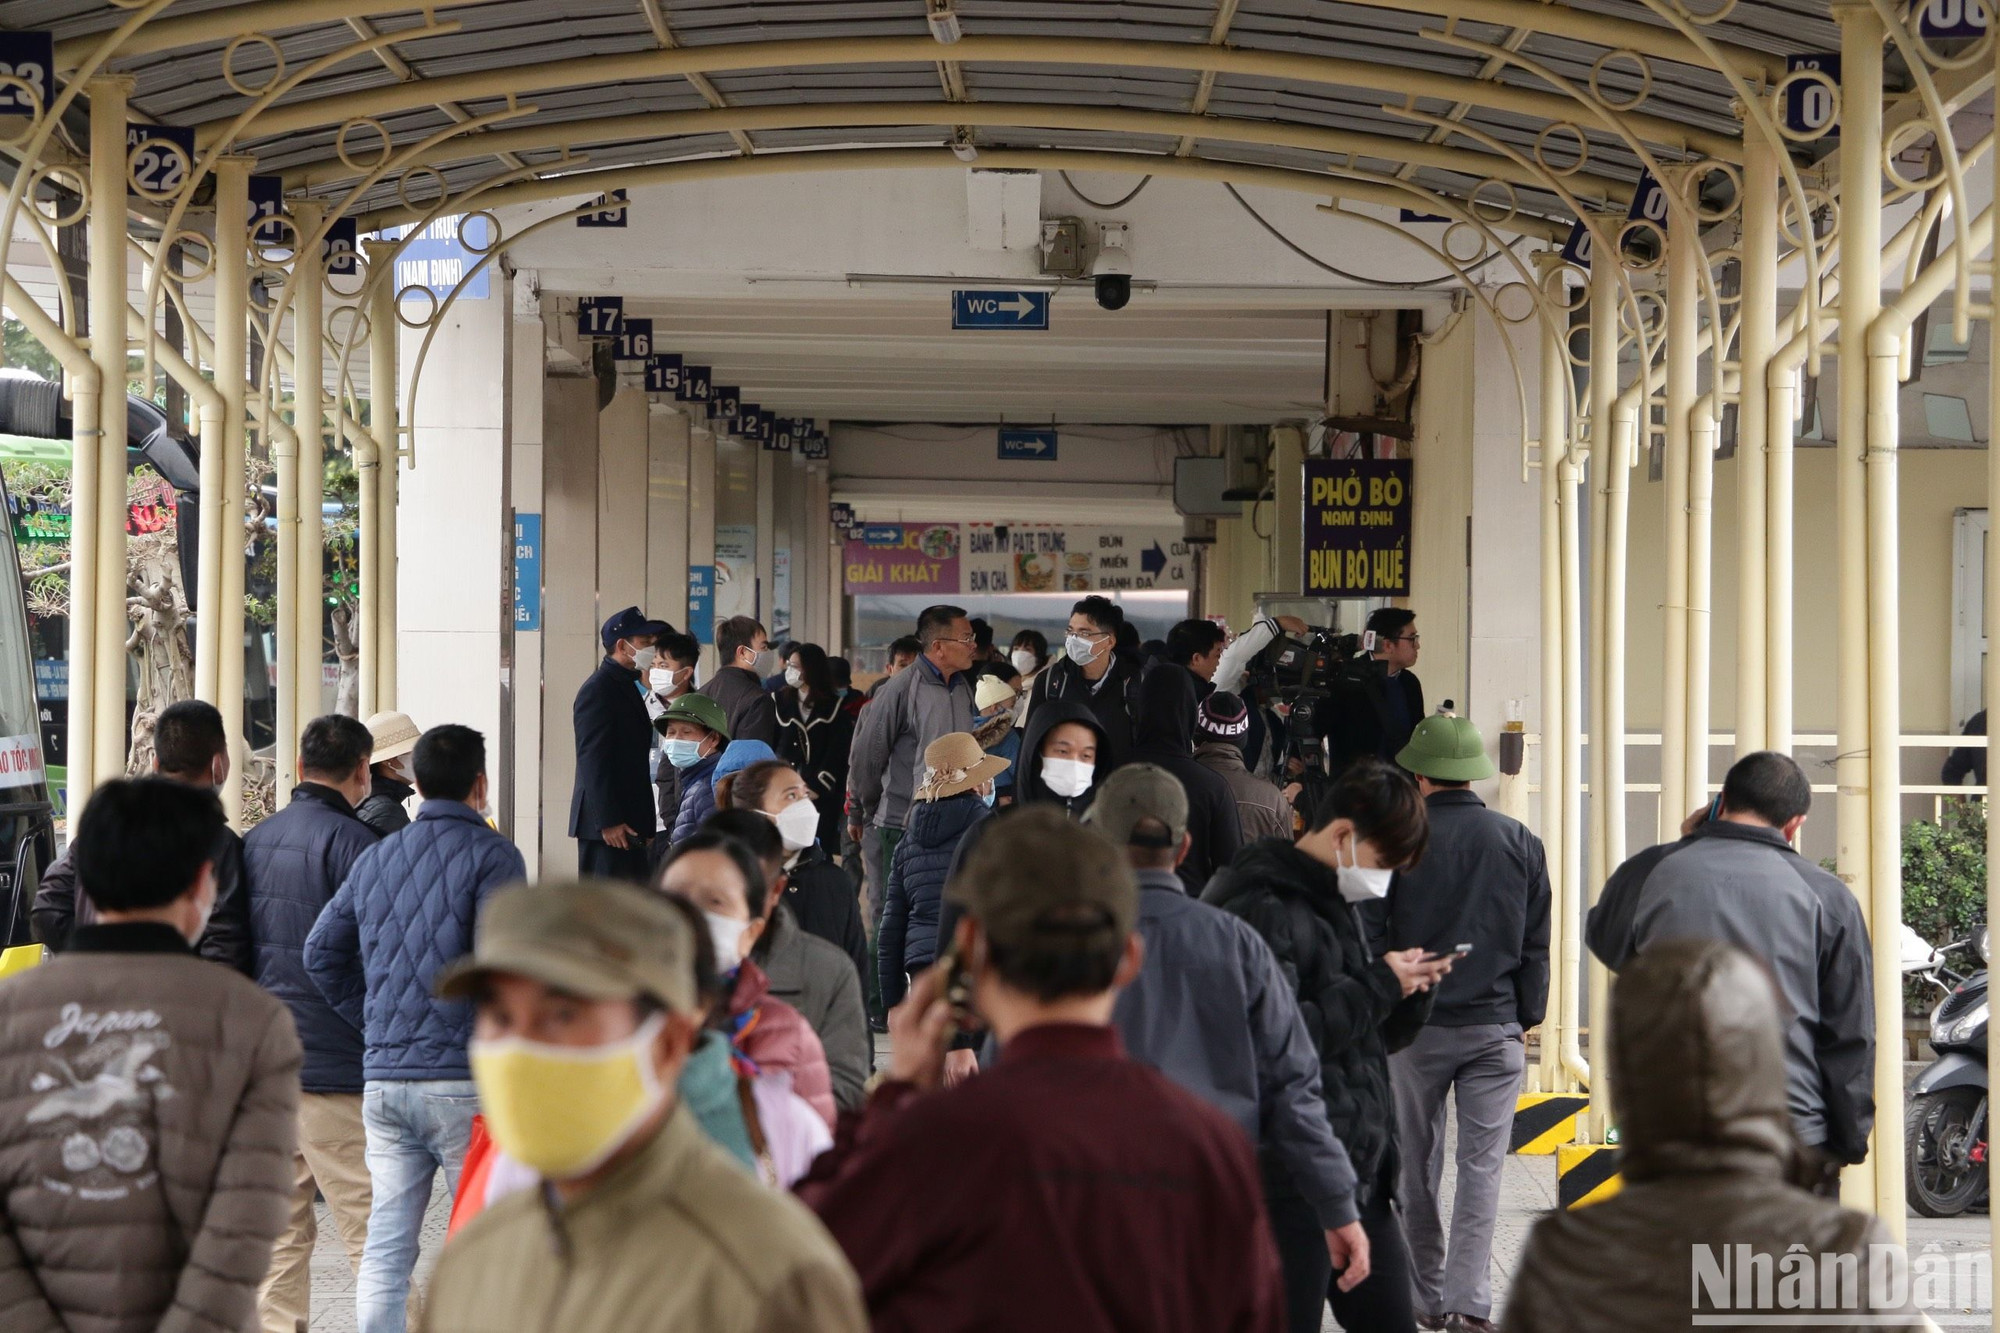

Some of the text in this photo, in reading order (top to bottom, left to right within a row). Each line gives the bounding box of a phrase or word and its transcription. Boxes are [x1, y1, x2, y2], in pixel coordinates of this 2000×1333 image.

[127, 129, 147, 145] A1
[134, 151, 185, 190] 22
[967, 299, 998, 314] WC
[588, 308, 618, 331] 17
[620, 334, 649, 356] 16
[652, 368, 679, 388] 15
[683, 380, 708, 398] 14
[714, 399, 737, 417] 13
[737, 416, 757, 432] 12
[1005, 440, 1023, 449] WC
[1312, 468, 1403, 506] PHỞ BÒ
[1322, 511, 1393, 529] NAM ĐỊNH
[1310, 535, 1404, 589] BÚN BÒ HUẾ
[44, 1003, 162, 1049] Japan
